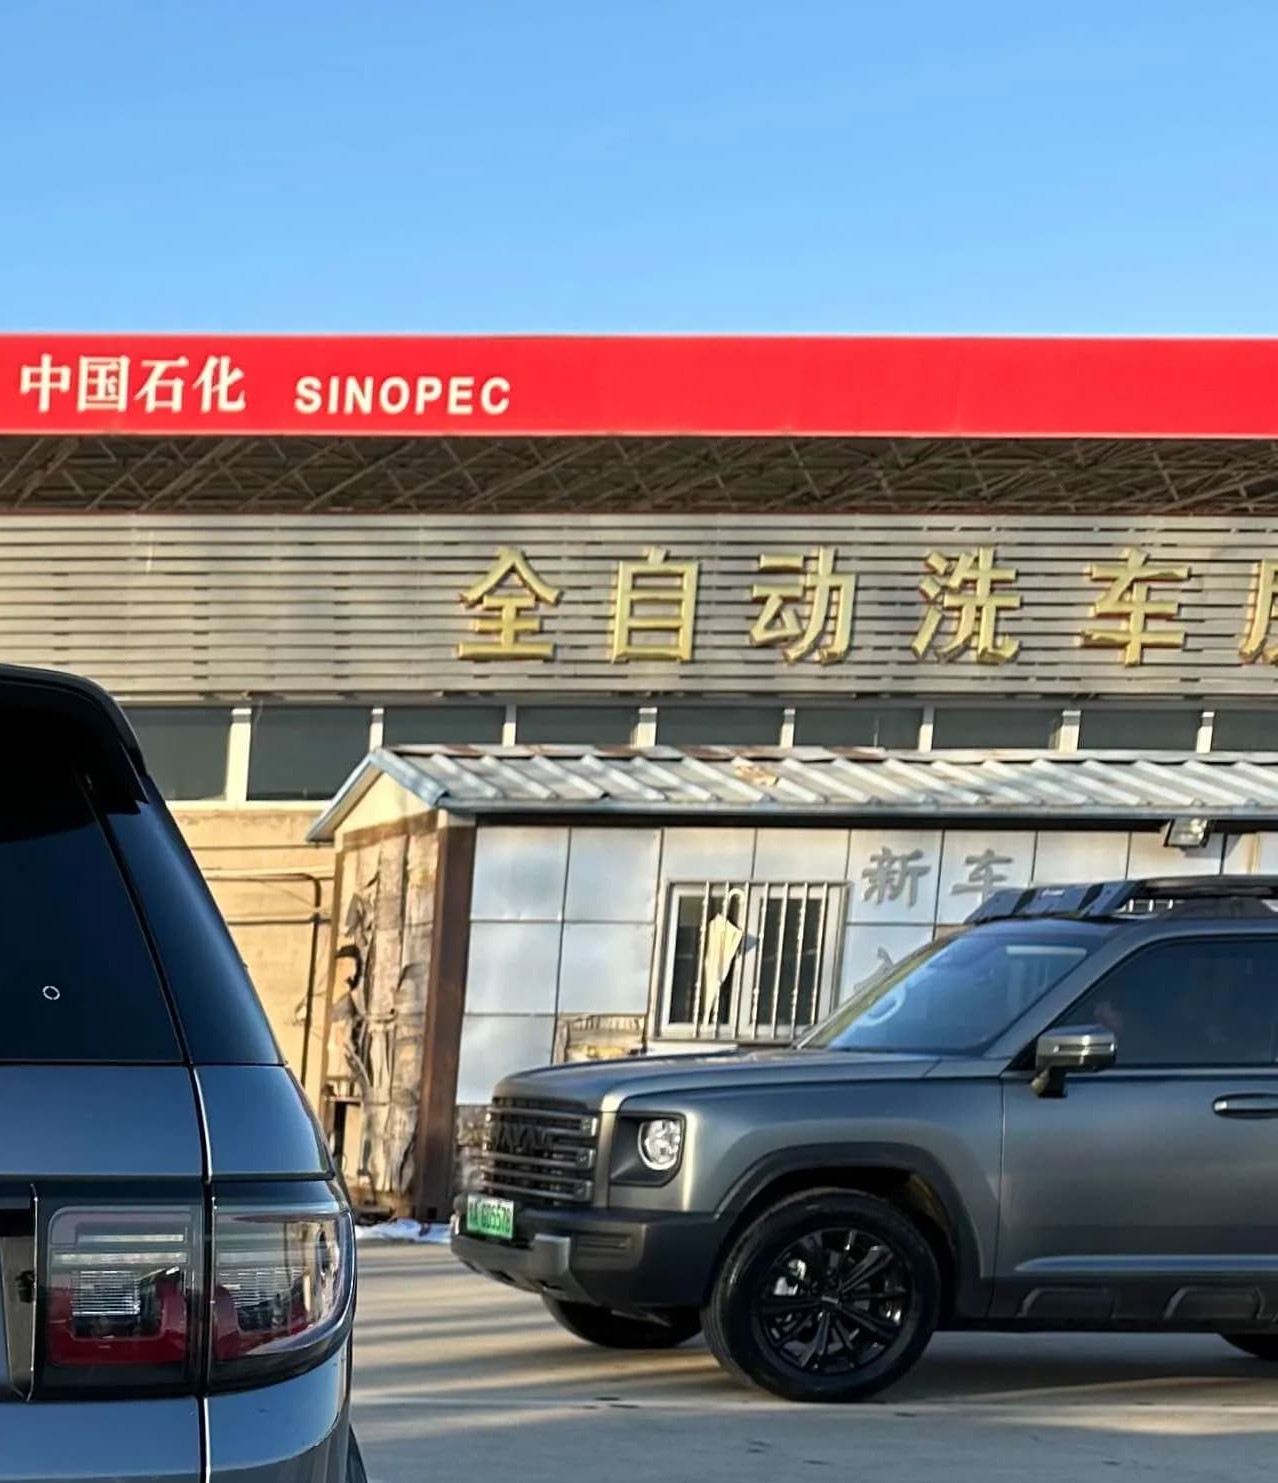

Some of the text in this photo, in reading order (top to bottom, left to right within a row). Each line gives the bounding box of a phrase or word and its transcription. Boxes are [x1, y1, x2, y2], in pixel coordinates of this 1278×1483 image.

[20, 353, 246, 413] 中国石化
[294, 376, 511, 415] SINOPEC
